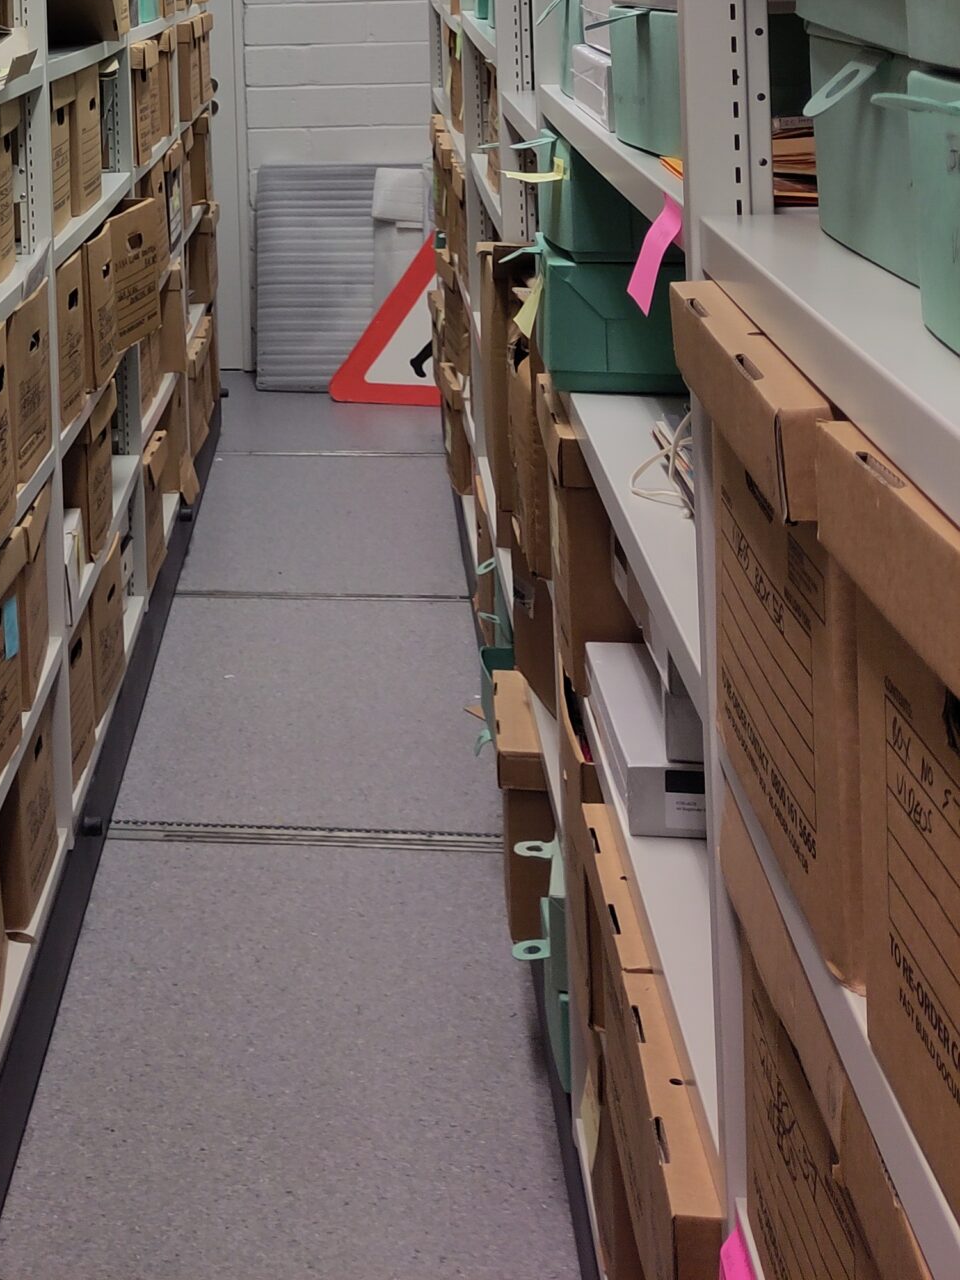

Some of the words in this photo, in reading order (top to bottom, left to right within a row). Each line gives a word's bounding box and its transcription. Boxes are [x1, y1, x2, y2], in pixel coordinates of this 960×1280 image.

[889, 932, 902, 969] TO
[901, 954, 951, 1056] RE-ORDER
[898, 987, 916, 1023] FAST
[914, 1014, 938, 1061] BUILD
